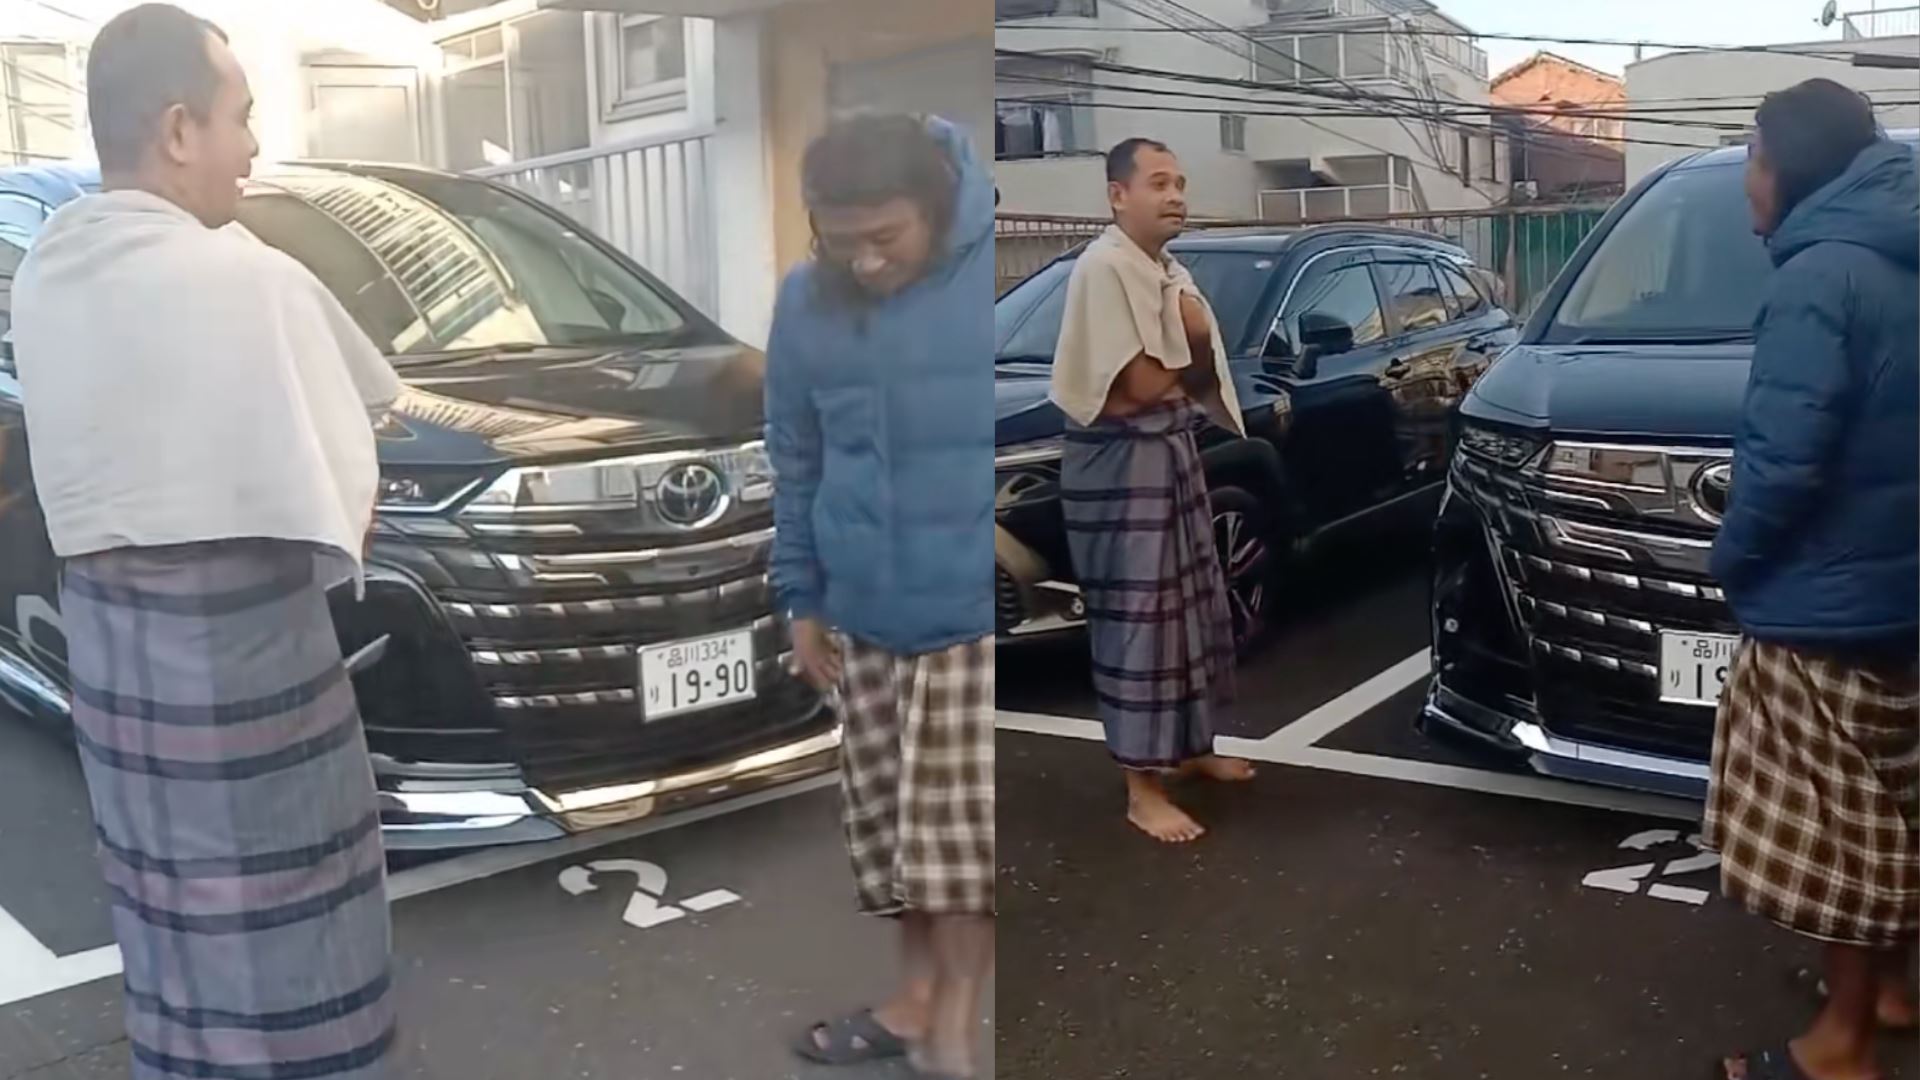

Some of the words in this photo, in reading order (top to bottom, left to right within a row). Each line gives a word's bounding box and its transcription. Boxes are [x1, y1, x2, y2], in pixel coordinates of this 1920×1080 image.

[672, 659, 748, 708] 19-90
[558, 858, 742, 928] 2
[1582, 829, 1721, 905] 2
